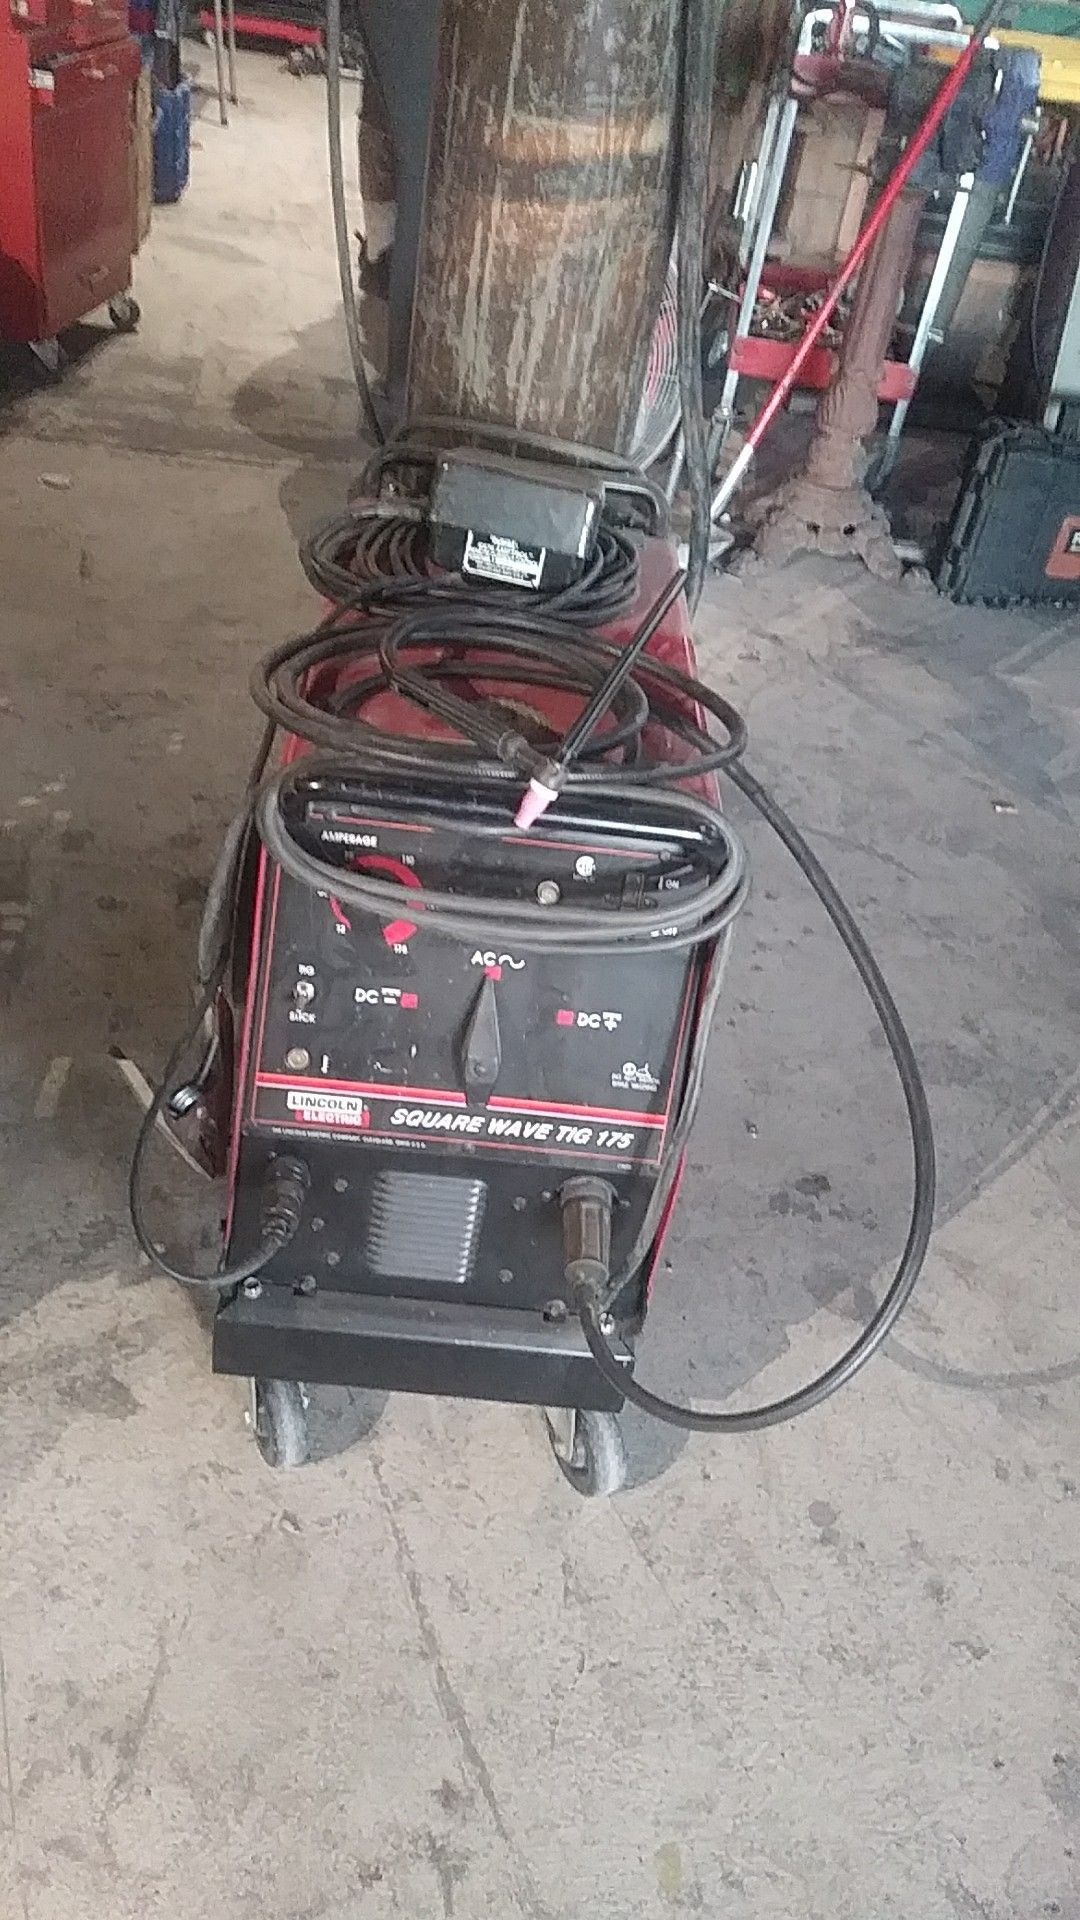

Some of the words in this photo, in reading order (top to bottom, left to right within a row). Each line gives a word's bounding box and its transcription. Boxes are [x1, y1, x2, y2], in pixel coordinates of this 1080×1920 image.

[321, 830, 377, 848] AMPERAGE
[471, 951, 496, 967] AC
[354, 987, 380, 1004] DC
[576, 1012, 601, 1029] DC
[292, 1095, 358, 1111] LINCOLN
[303, 1109, 362, 1126] ELECTRIC
[390, 1108, 486, 1133] SQUARE
[487, 1117, 554, 1141] WAVE
[555, 1125, 593, 1145] TIG
[596, 1130, 635, 1149] 175
